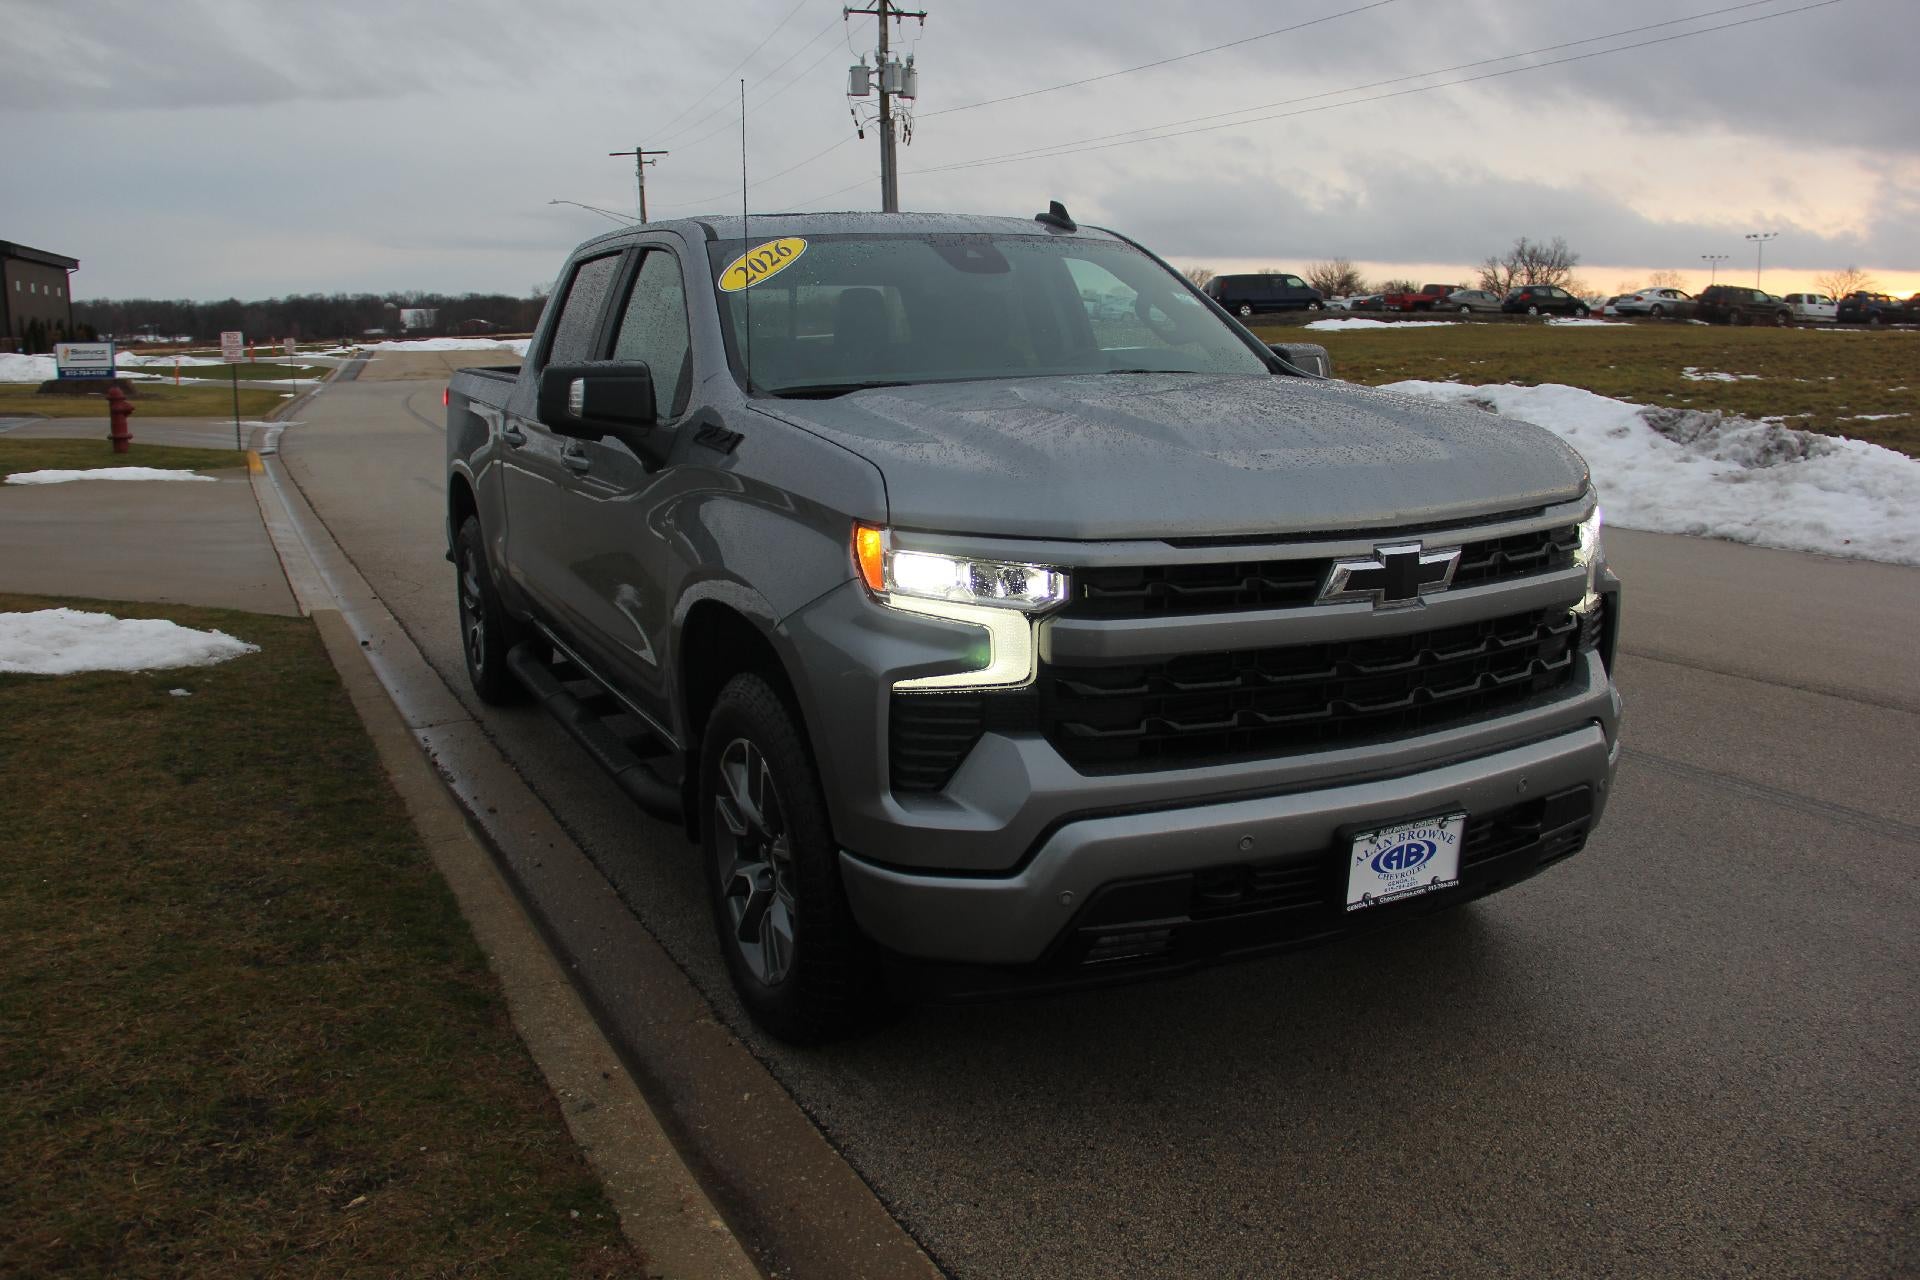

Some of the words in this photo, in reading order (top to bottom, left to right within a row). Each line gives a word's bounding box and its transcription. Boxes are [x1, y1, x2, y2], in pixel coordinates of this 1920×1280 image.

[734, 243, 792, 285] 2026
[1356, 838, 1392, 866] ALAN
[1399, 829, 1456, 845] BROWNE
[1383, 843, 1426, 870] AB
[1378, 864, 1427, 880] CHEVROLET
